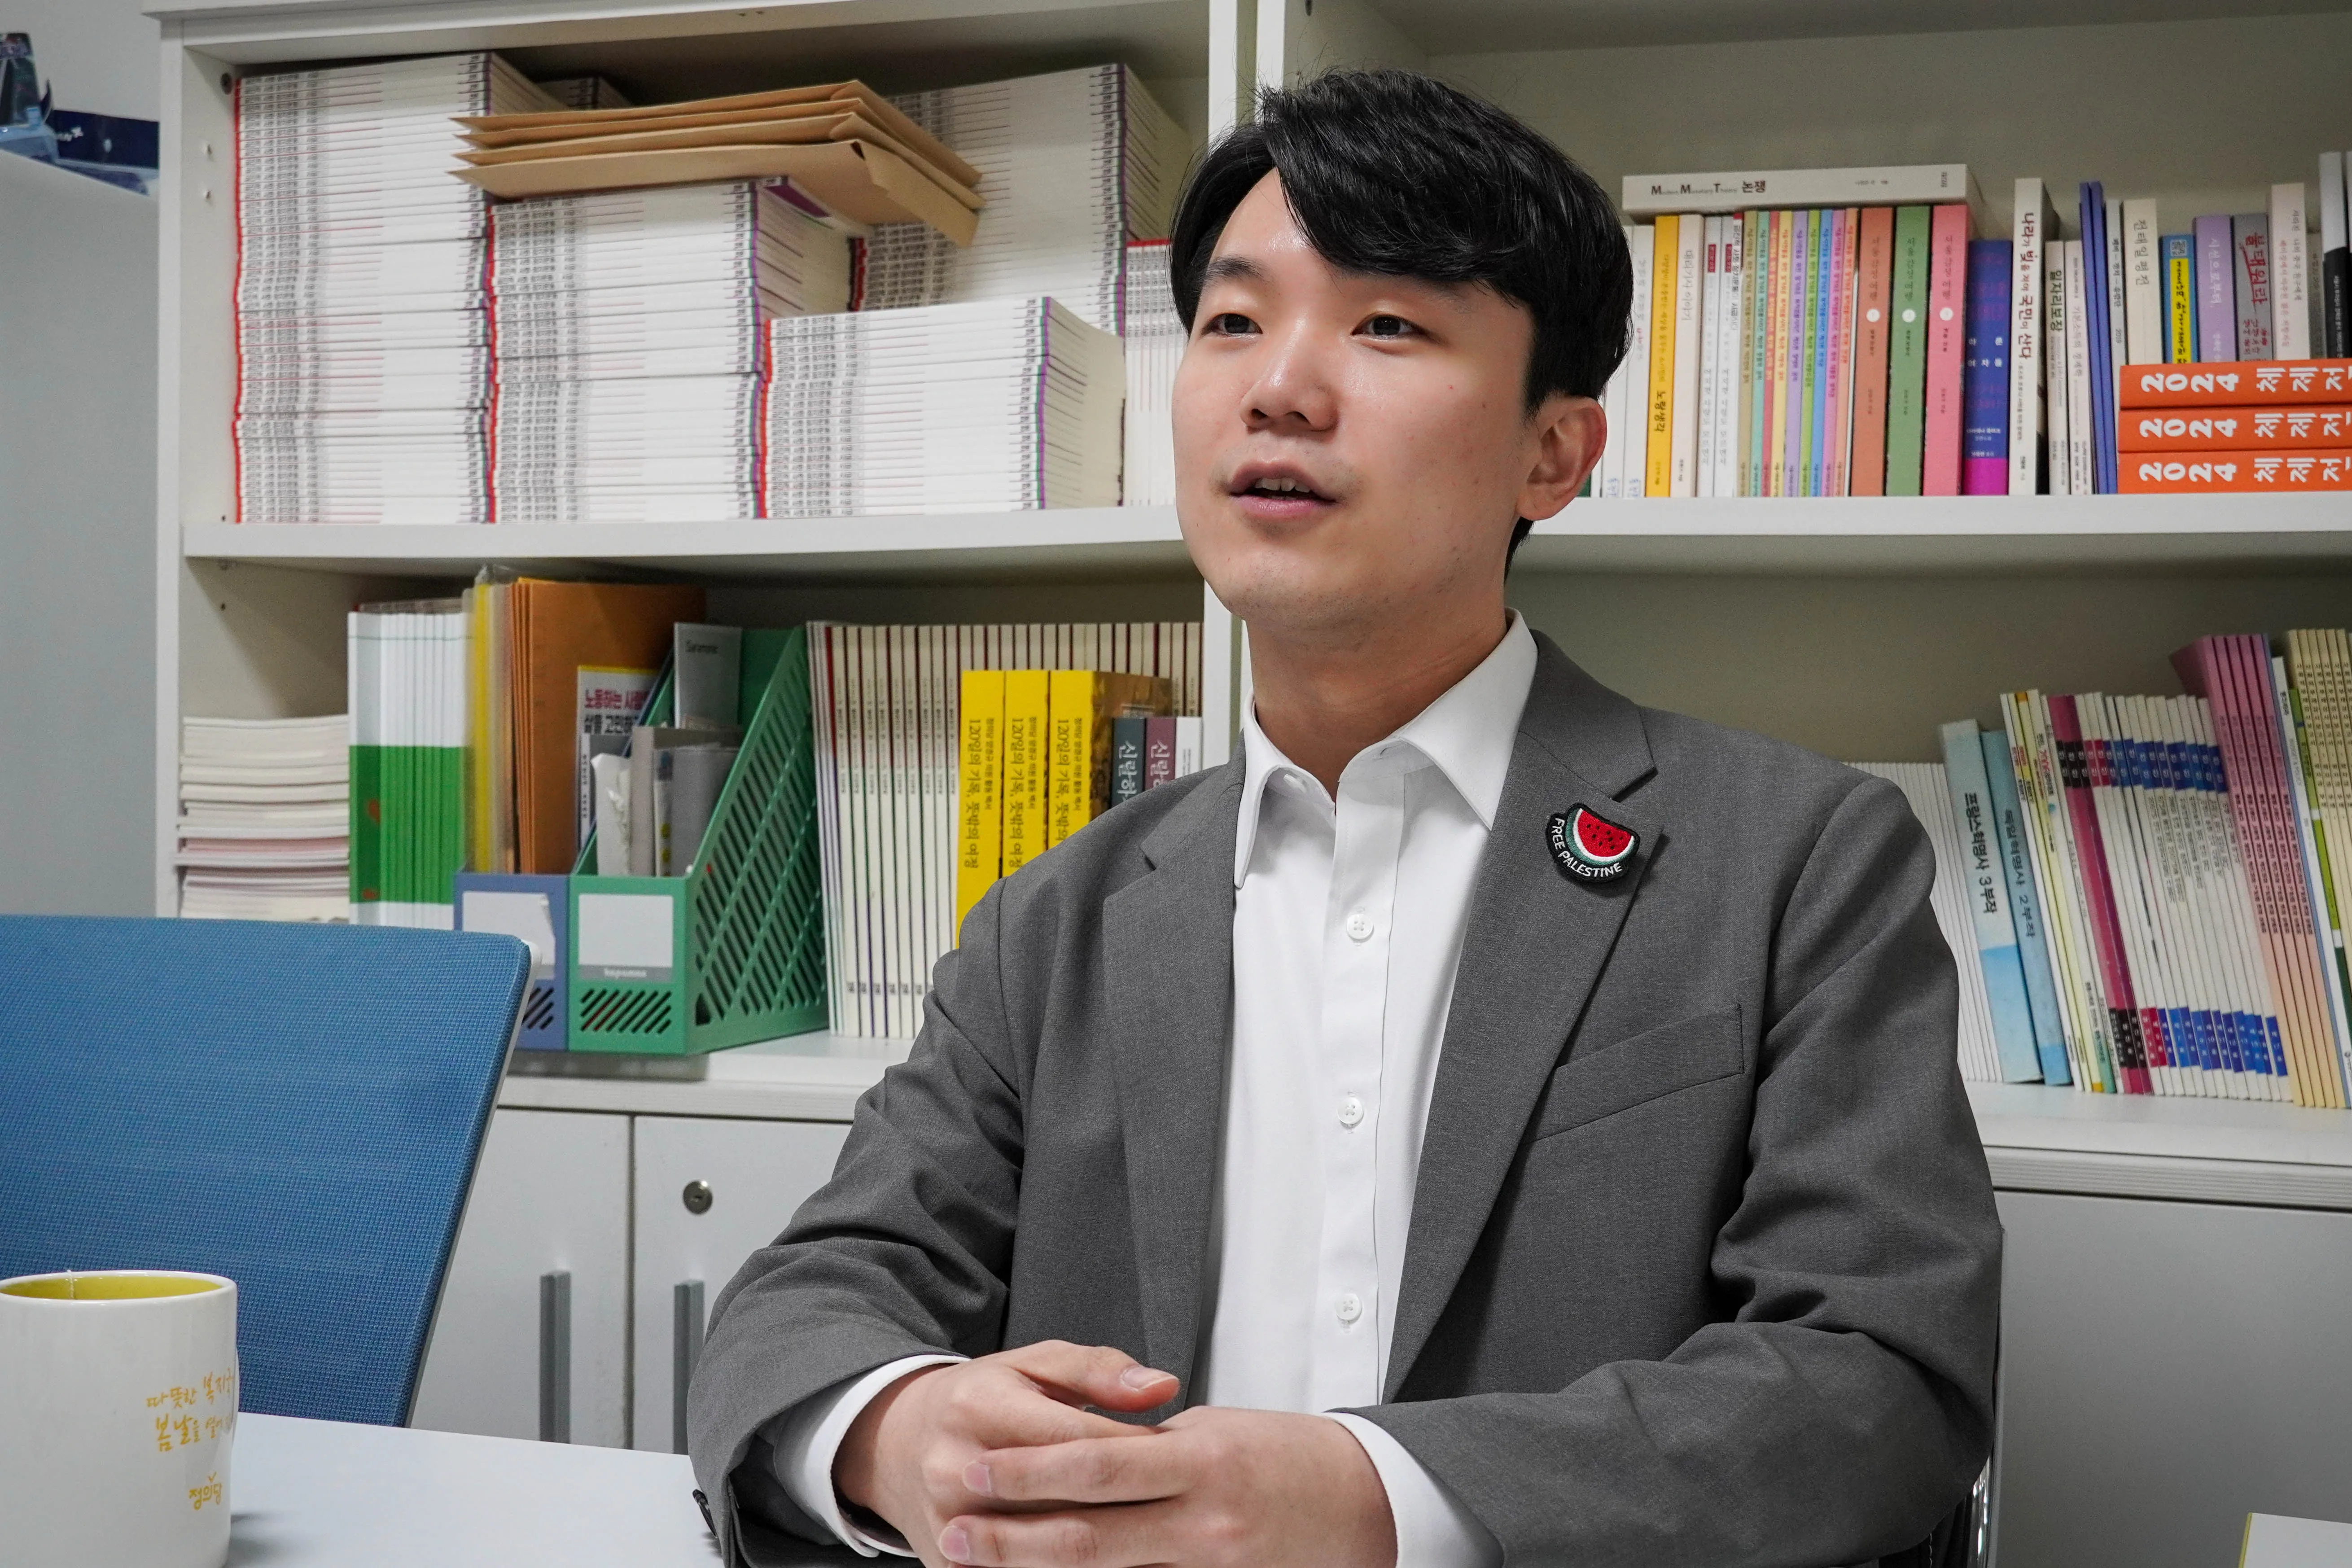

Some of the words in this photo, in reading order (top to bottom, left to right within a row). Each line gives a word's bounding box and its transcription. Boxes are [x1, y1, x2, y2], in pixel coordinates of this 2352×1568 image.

[1742, 180, 1766, 193] 논쟁
[2021, 212, 2034, 248] 나라가
[1683, 250, 1695, 289] 대리기사
[2020, 250, 2038, 272] 빚을
[2208, 238, 2221, 308] 시선으로부터,
[2021, 274, 2029, 292] 져야
[1682, 291, 1692, 320] 이야기
[2019, 294, 2032, 329] 국민이
[2050, 270, 2063, 332] 일자리보장
[2072, 306, 2082, 348] 기본소득의
[2018, 333, 2032, 359] 산다
[2141, 372, 2239, 393] 2024
[2139, 417, 2238, 438] 2024
[2139, 462, 2237, 482] 2024
[967, 718, 982, 766] 120일의
[1011, 717, 1025, 764] 120일의
[1056, 718, 1071, 766] 120일의
[966, 770, 981, 798] 기록,
[1009, 768, 1025, 797] 기록,
[1055, 770, 1070, 799] 기록,
[1117, 740, 1138, 802] 신랄하
[965, 803, 981, 840] 뜻밖의
[1009, 802, 1024, 839] 뜻밖의
[1055, 802, 1069, 841] 뜻밖의
[1551, 818, 1566, 850] FREE
[964, 843, 980, 869] 여정
[1009, 842, 1024, 868] 여정
[1558, 850, 1622, 877] PALESTINE
[1963, 792, 1991, 871] 프랑스혁명사
[1979, 876, 1997, 915] 3부작
[2003, 808, 2026, 885] 독일혁명사
[2019, 893, 2036, 938] 2부작
[145, 1386, 197, 1409] 따뜻한
[188, 1482, 223, 1510] 정의당
